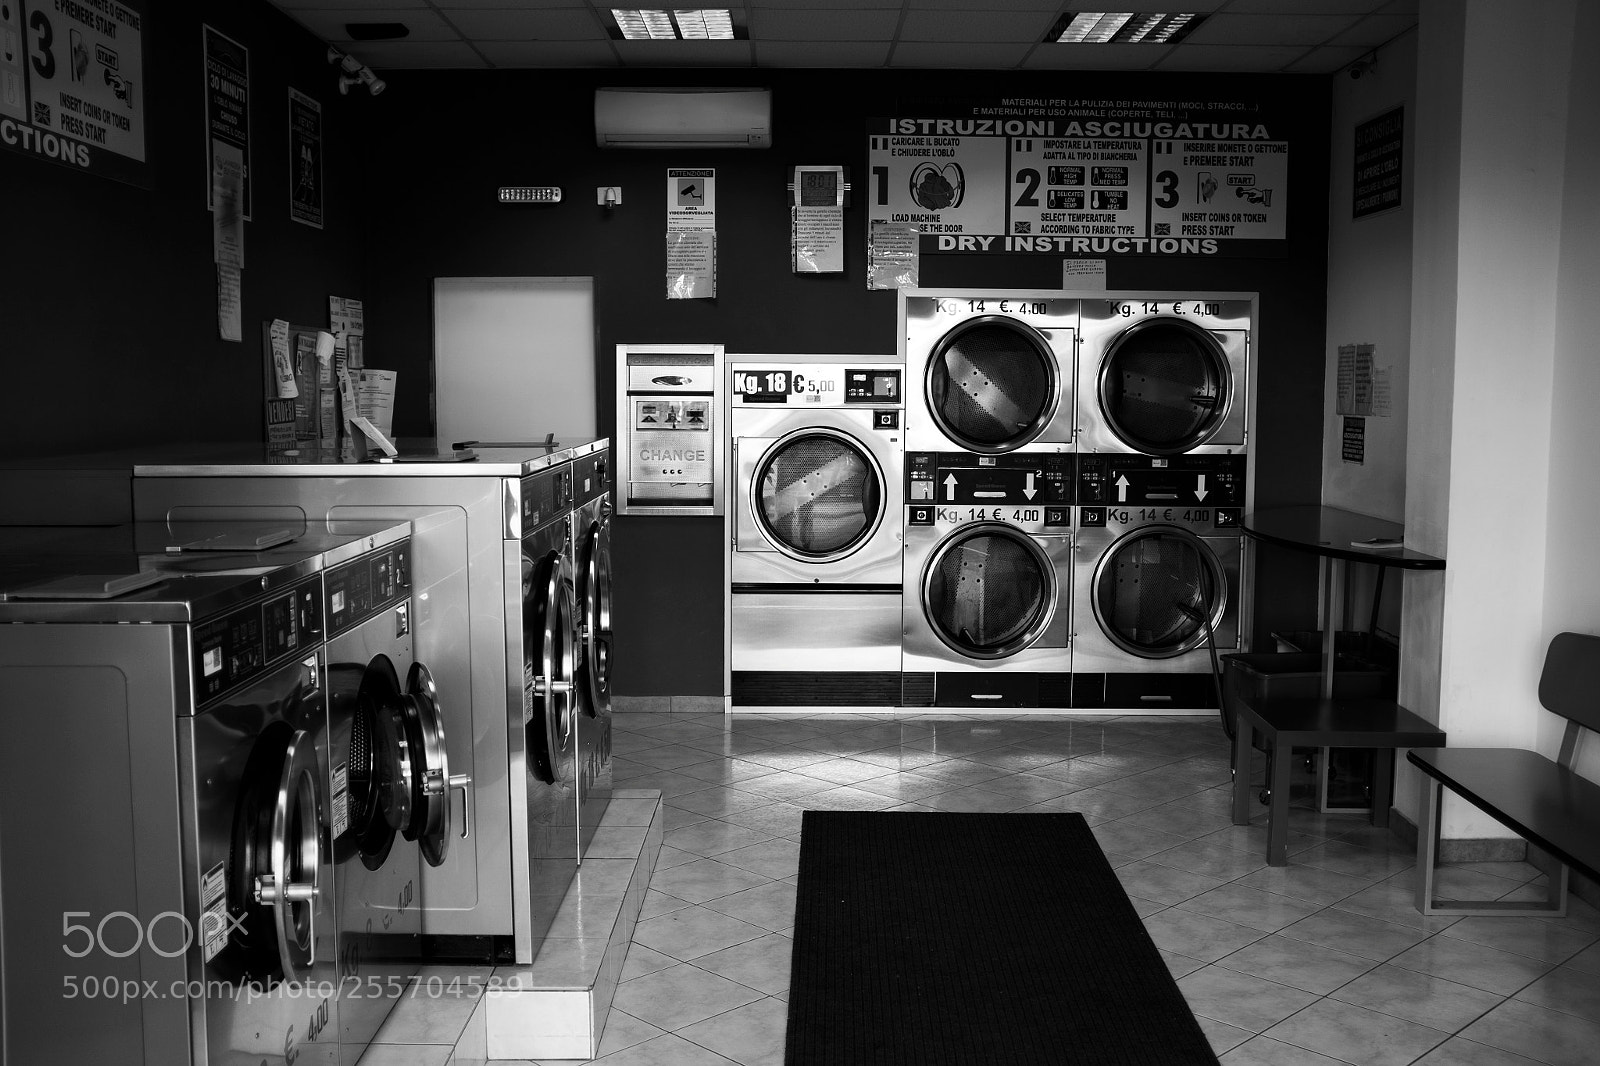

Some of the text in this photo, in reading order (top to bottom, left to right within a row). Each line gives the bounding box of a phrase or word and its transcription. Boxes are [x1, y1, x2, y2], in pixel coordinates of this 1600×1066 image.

[60, 0, 94, 29] PREMERE
[95, 15, 117, 39] START
[115, 6, 140, 31] GETTONE
[30, 10, 55, 80] 3
[97, 49, 117, 67] START
[210, 73, 246, 103] 30 MINUTI
[60, 91, 130, 132] INSERT COINS OR TOKEN
[1002, 98, 1047, 107] MATERIALI
[1049, 99, 1067, 108] PER
[1069, 100, 1080, 108] LA
[1081, 100, 1113, 109] PULIZIA
[1116, 101, 1130, 109] DEI
[1132, 101, 1176, 110] PAVIMENTI
[981, 108, 1026, 116] MATERIALI
[1047, 109, 1066, 117] USO
[1068, 110, 1106, 118] ANIMALE
[60, 112, 107, 144] PRESS START
[889, 118, 1270, 139] ISTRUZIONI ASCIUGATURA
[891, 137, 960, 147] CARICARE IL BUCATO
[1043, 139, 1142, 150] IMPOSTARE LA TEMPERATURA
[1183, 142, 1287, 153] INSERIRE MONETE O GETTONE
[891, 148, 896, 157] E
[897, 148, 931, 157] CHIUDERE
[1043, 151, 1138, 161] ADATTA AL TIPO DI BIANCHERIA
[1189, 155, 1227, 167] PREMERE
[1229, 156, 1255, 167] START
[872, 166, 889, 205] 1
[1014, 168, 1041, 207] 2
[1155, 170, 1179, 208] 3
[891, 213, 941, 223] LOAD MACHINE
[1041, 213, 1117, 223] SELECT TEMPERATURE
[1182, 212, 1267, 223] INSERT COINS OR TOKEN
[930, 224, 943, 233] THE
[944, 224, 963, 233] DOOR
[1040, 224, 1135, 235] ACCORDING TO FABRIC TYPE
[1181, 224, 1235, 236] PRESS START
[938, 236, 1219, 254] DRY INSTRUCTIONS
[936, 299, 1047, 315] Kg. 14 €. 4,00
[1110, 301, 1220, 317] Kg. 14 €. 4,00
[734, 372, 834, 395] Kg. 18 € 5,00
[639, 449, 705, 461] CHANGE
[1035, 469, 1043, 478] 2
[1112, 470, 1116, 479] 1
[937, 507, 1039, 524] Kg. 14 €. 4,00
[1108, 508, 1209, 524] Kg. 14 €. 4,00
[308, 998, 329, 1042] 4,00
